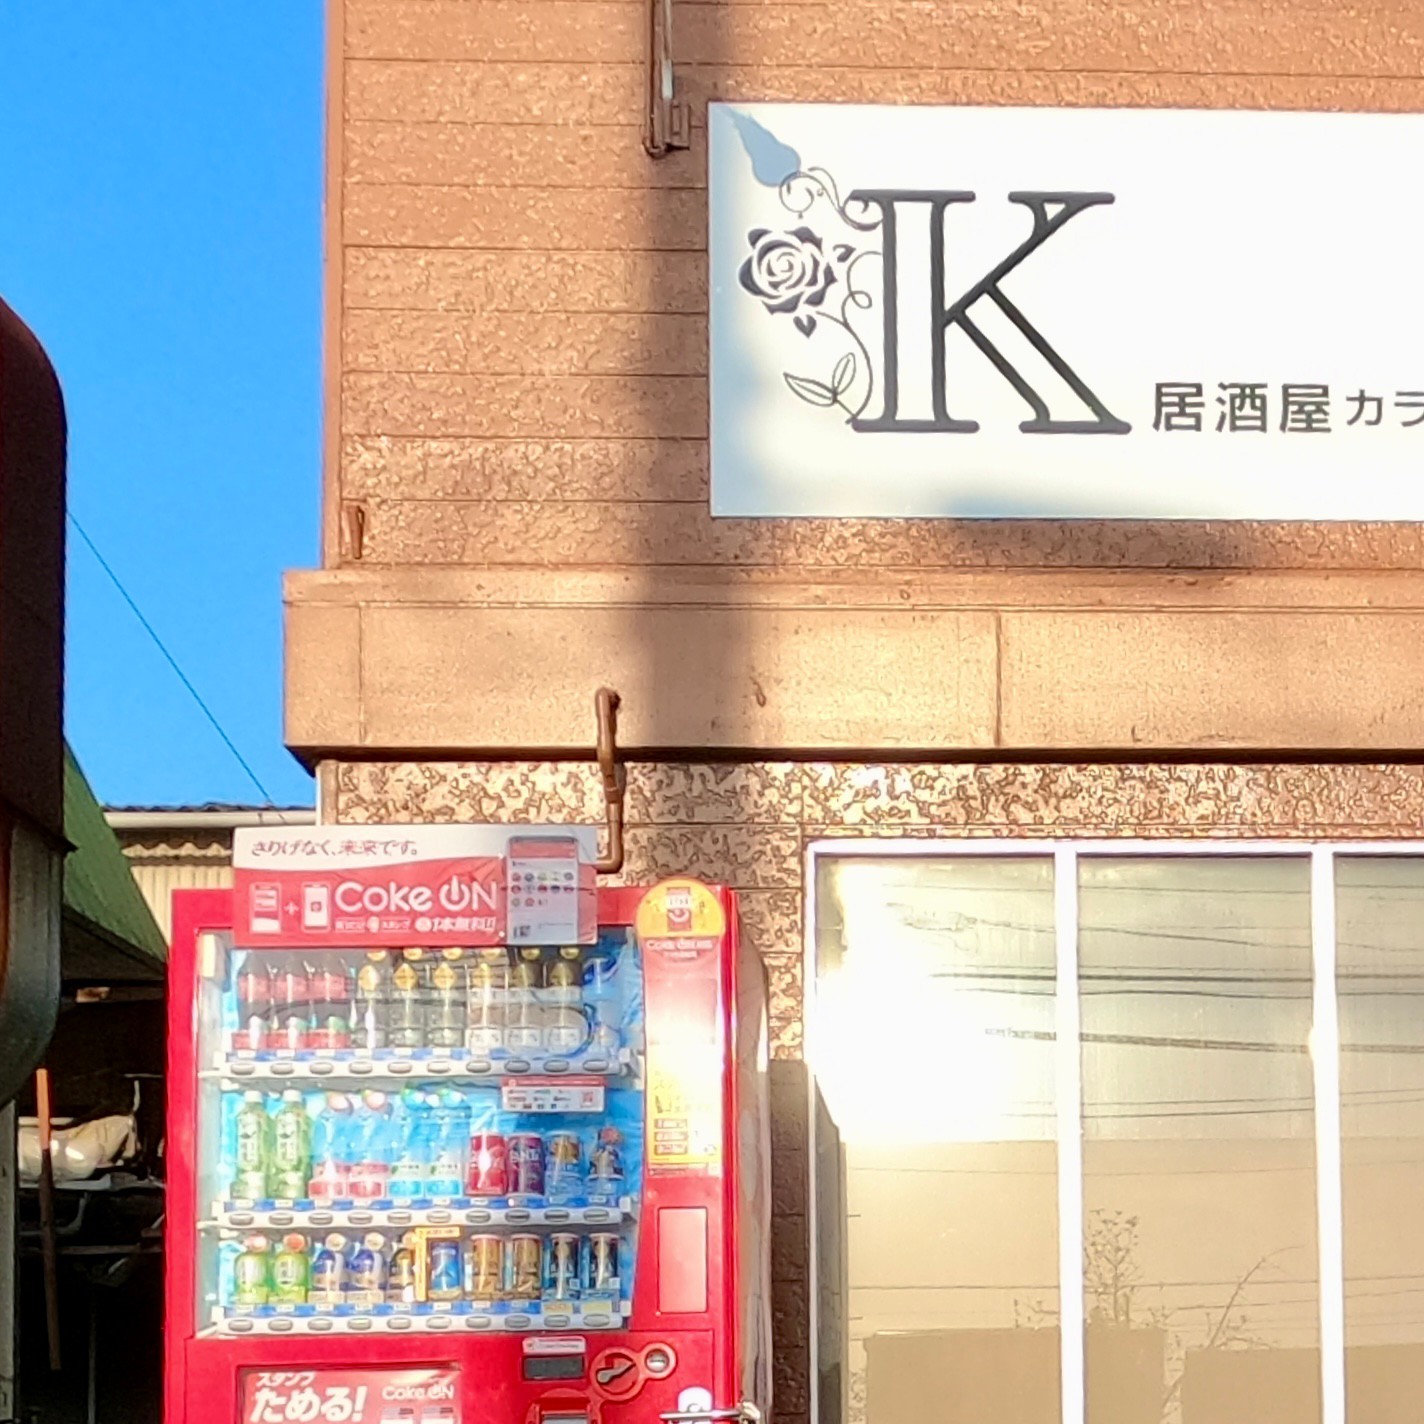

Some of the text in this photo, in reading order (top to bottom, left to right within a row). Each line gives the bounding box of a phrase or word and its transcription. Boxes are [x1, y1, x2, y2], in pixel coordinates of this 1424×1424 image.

[848, 189, 1132, 435] K
[335, 874, 498, 913] Coke ON
[249, 1385, 368, 1424] ためる!
[381, 1384, 424, 1402] Coke
